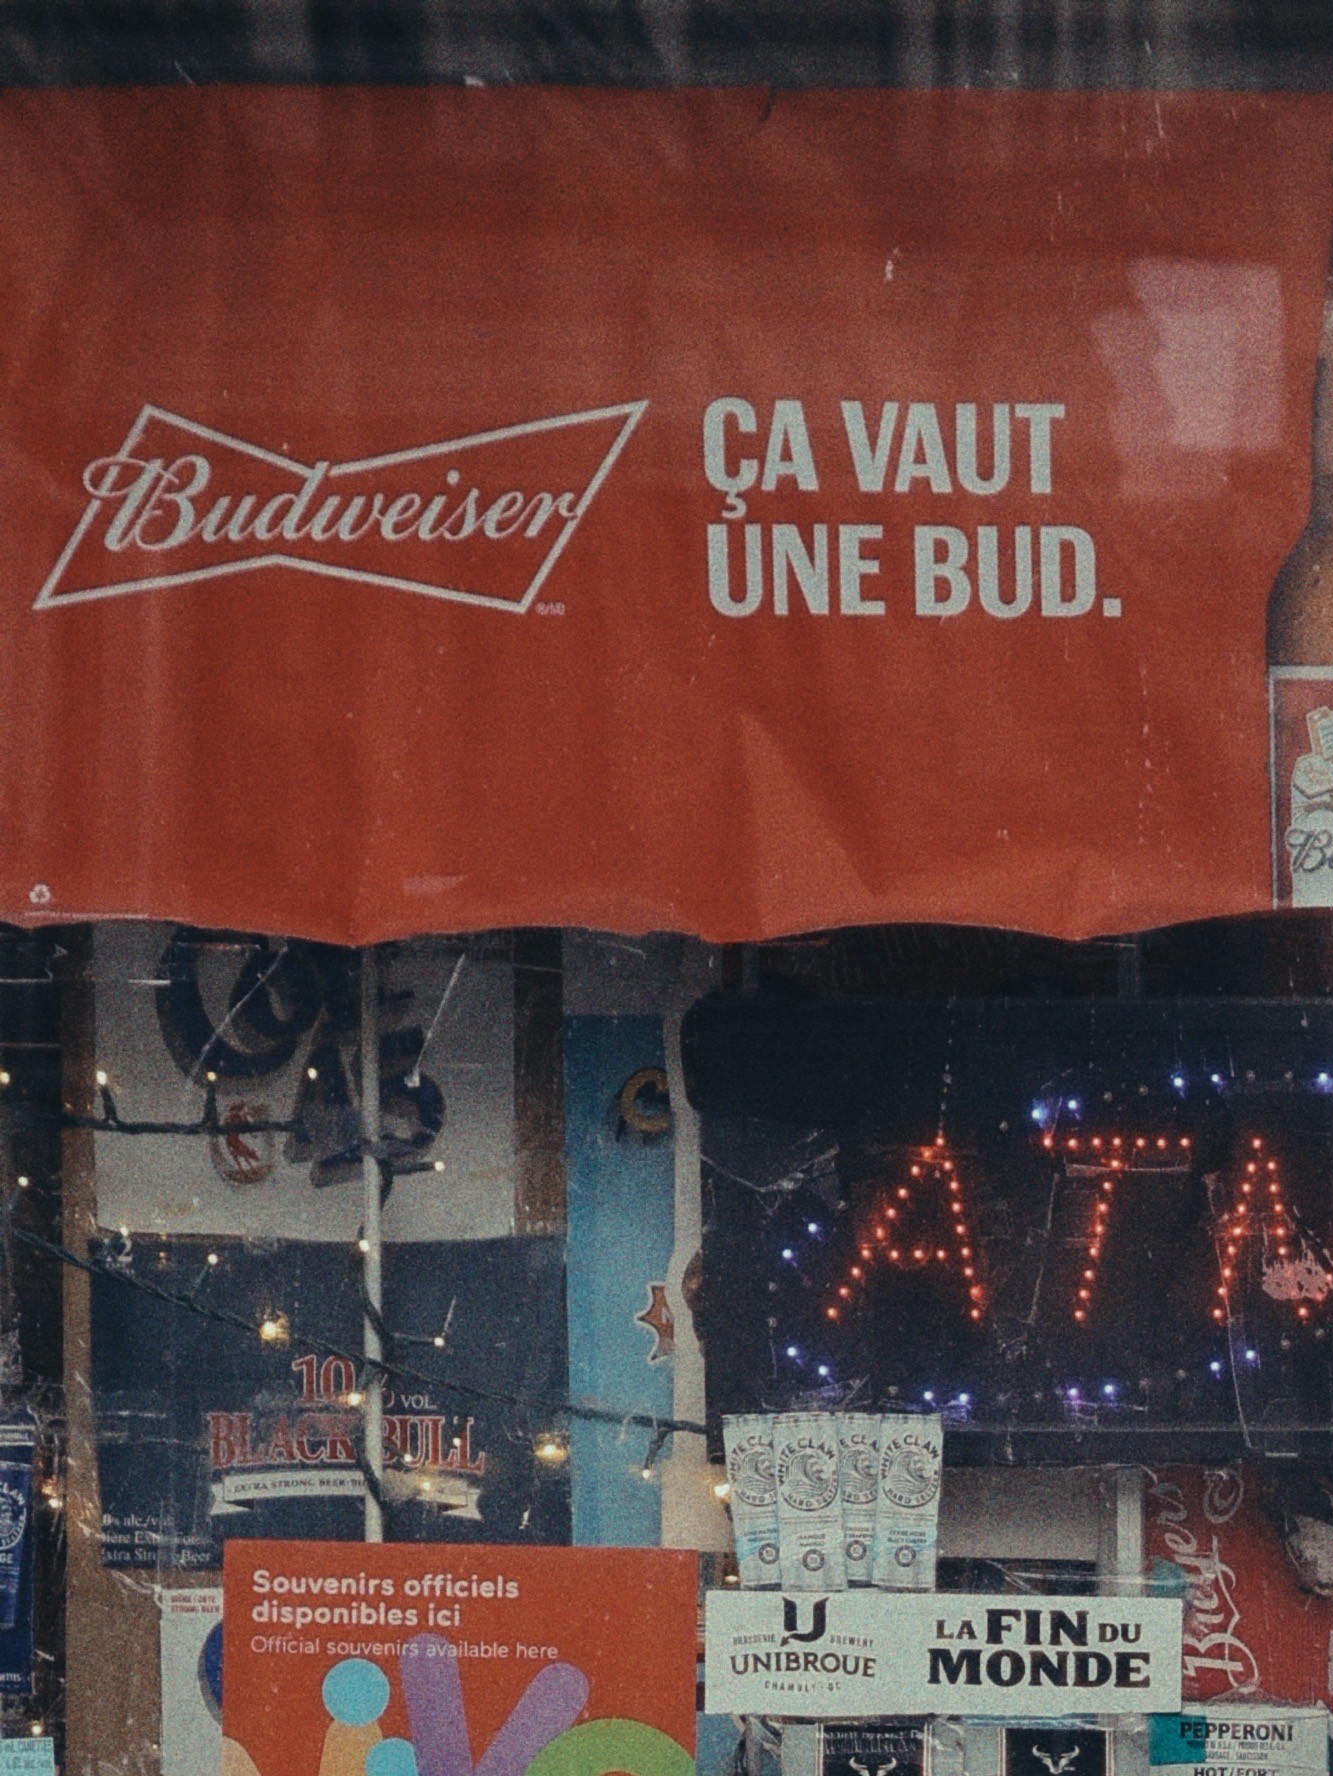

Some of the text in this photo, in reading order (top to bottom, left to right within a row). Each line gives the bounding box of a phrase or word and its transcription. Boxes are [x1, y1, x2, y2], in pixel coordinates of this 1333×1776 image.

[702, 396, 1065, 518] ÇA VAUT
[82, 455, 590, 554] Budweiser
[706, 524, 1123, 620] UNE BUD.
[206, 1411, 357, 1470] BLACK
[797, 1437, 835, 1460] CLAW
[903, 1434, 940, 1459] CLAW
[252, 1569, 520, 1600] Souvenirs officiels
[251, 1600, 419, 1629] disponibles
[428, 1603, 461, 1627] ici
[935, 1608, 1143, 1647] LA FIN DU
[250, 1635, 558, 1660] Official souvenirs available here
[729, 1652, 877, 1678] UNIBROUE
[926, 1646, 1151, 1689] MONDE
[1179, 1721, 1294, 1742] PEPPERONI
